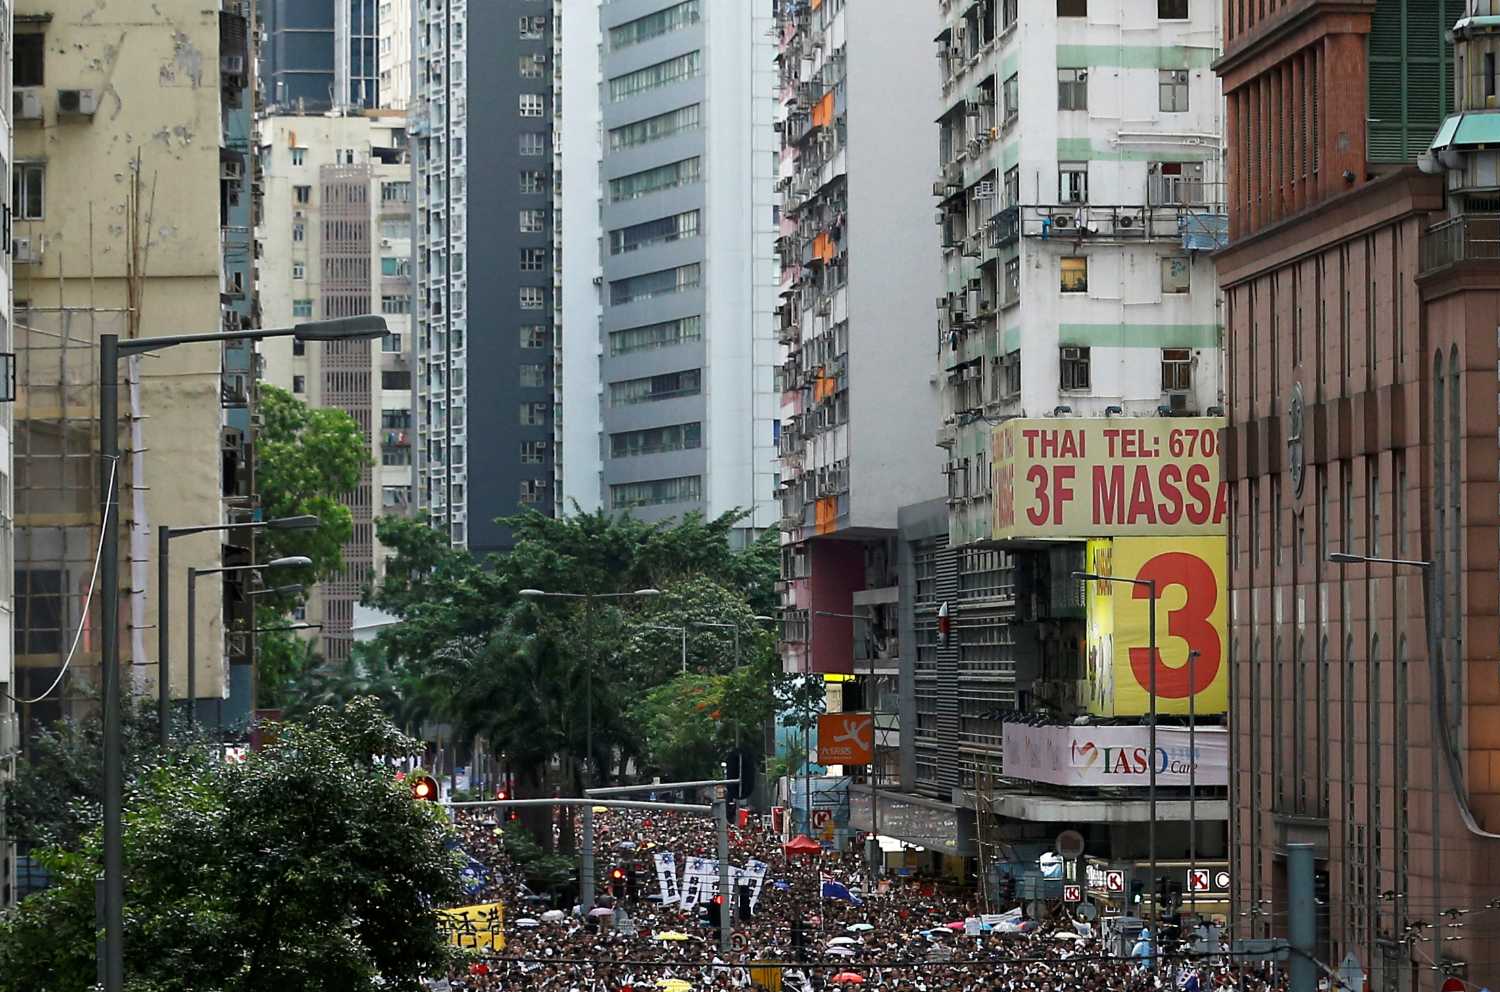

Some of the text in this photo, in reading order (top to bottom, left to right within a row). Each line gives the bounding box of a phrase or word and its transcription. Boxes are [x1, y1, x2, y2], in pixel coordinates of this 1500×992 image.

[1022, 430, 1086, 458] THAI
[1103, 429, 1160, 457] TEL:
[1026, 464, 1076, 526] 3F
[1129, 551, 1220, 699] 3
[1103, 747, 1168, 774] IASO
[1170, 760, 1198, 774] Care
